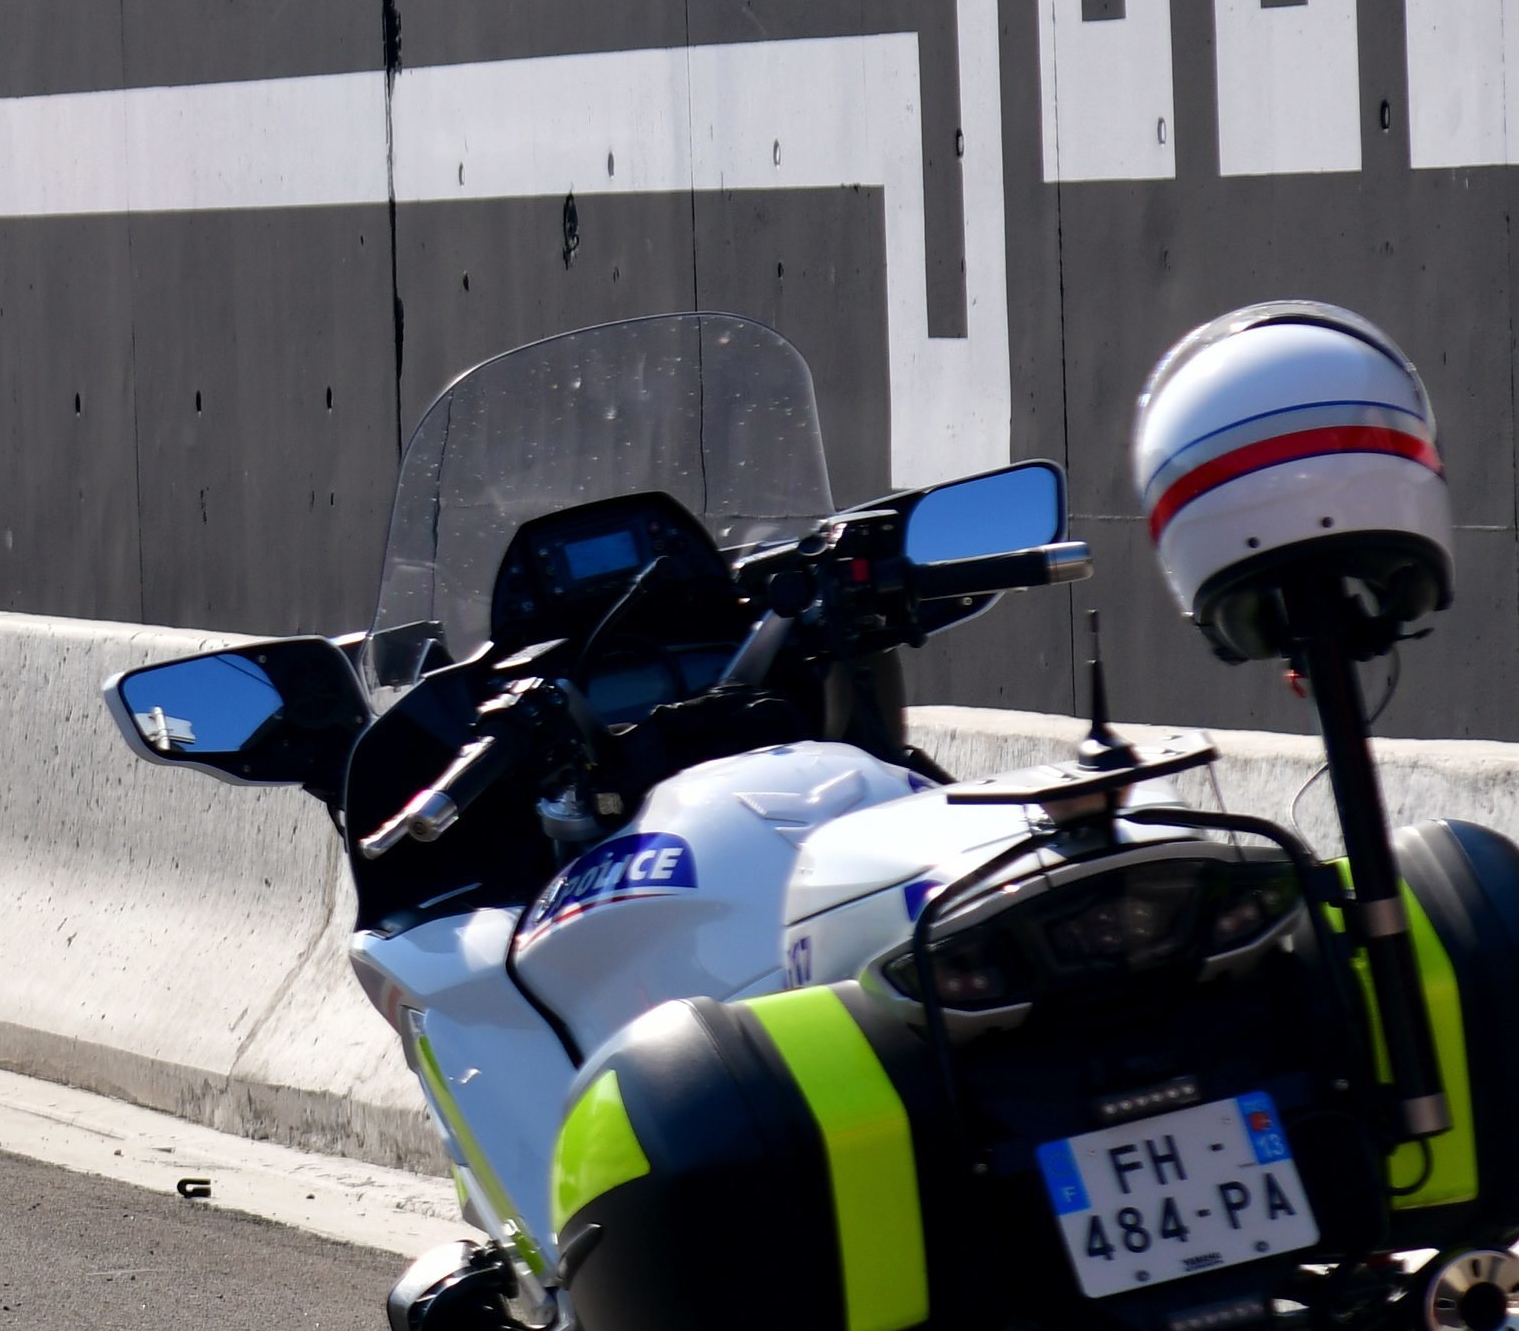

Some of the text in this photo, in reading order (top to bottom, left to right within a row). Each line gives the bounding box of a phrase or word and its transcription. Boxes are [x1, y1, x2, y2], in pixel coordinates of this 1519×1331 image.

[1064, 1185, 1077, 1203] F
[1107, 1134, 1188, 1195] FH
[1085, 1172, 1297, 1261] 484-PA
